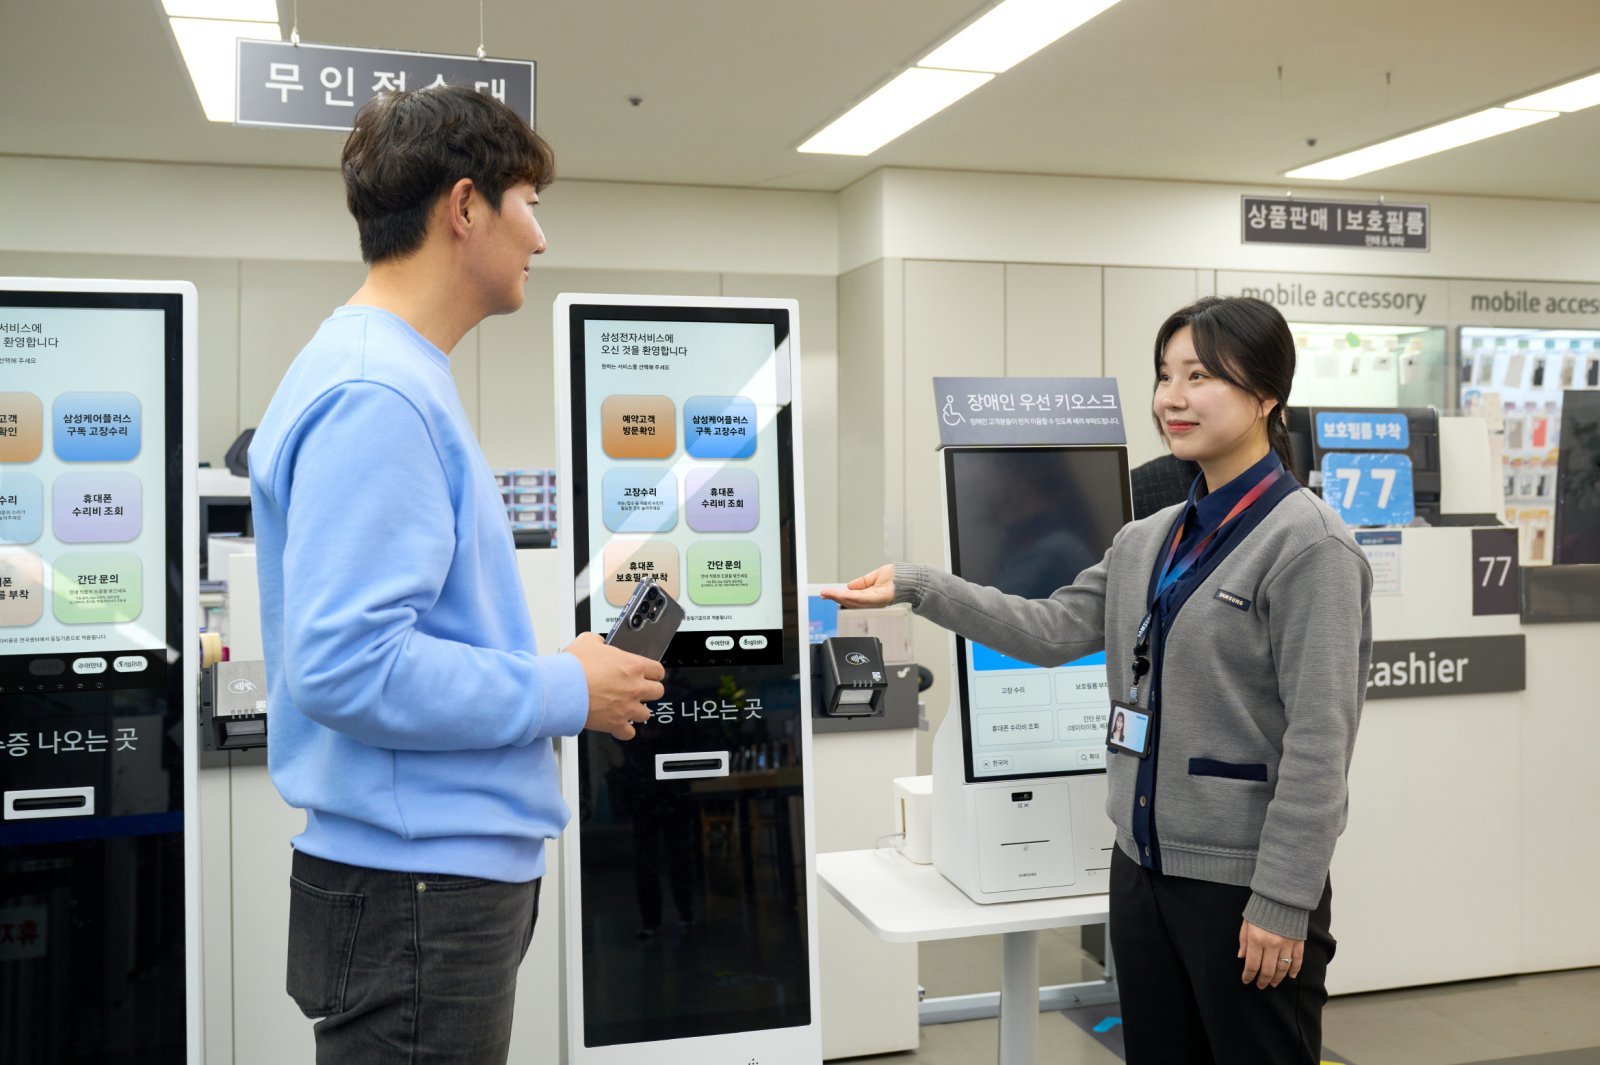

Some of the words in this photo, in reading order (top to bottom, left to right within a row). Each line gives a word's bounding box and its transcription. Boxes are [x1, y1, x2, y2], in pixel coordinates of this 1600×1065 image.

[1248, 203, 1328, 231] 상품판매
[1346, 209, 1424, 236] 보호필름
[1241, 283, 1316, 307] mobile
[1322, 286, 1426, 314] accessory
[1471, 290, 1541, 313] mobile
[3, 337, 59, 348] 환영합니다
[600, 332, 674, 344] 삼성전자서비스에
[601, 345, 620, 354] 오신
[622, 346, 640, 356] 것을
[642, 346, 688, 356] 환영합니다
[967, 394, 1016, 412] 장애인
[1019, 394, 1051, 411] 우선
[1054, 394, 1118, 411] 키오스크
[63, 414, 132, 424] 삼성케어플러스
[622, 414, 656, 424] 예약고객
[692, 416, 749, 424] 삼성케어플러스
[66, 426, 86, 436] 구독
[89, 426, 128, 436] 고장수리
[622, 426, 656, 436] 방문확인
[696, 427, 712, 436] 구독
[714, 427, 746, 436] 고장수리
[1324, 422, 1372, 440] 보호필름
[1375, 422, 1401, 440] 부착
[624, 488, 656, 497] 고장수리
[710, 488, 734, 497] 휴대폰
[1336, 468, 1396, 510] 77
[82, 494, 112, 504] 휴대폰
[702, 499, 726, 508] 수리비
[728, 499, 744, 508] 조회
[72, 506, 102, 516] 수리비
[104, 506, 123, 516] 조회
[630, 562, 654, 570] 휴대폰
[708, 560, 724, 570] 간단
[725, 560, 741, 570] 문의
[1478, 556, 1512, 587] 77
[0, 577, 12, 587] 폰
[78, 574, 98, 584] 간단
[99, 574, 118, 584] 문의
[652, 572, 668, 582] 부착
[8, 590, 30, 600] 부착
[1219, 592, 1244, 606] SAMSUNG
[681, 700, 738, 722] 나오는
[744, 698, 763, 720] 곳
[38, 730, 108, 754] 나오는
[114, 728, 138, 751] 곳
